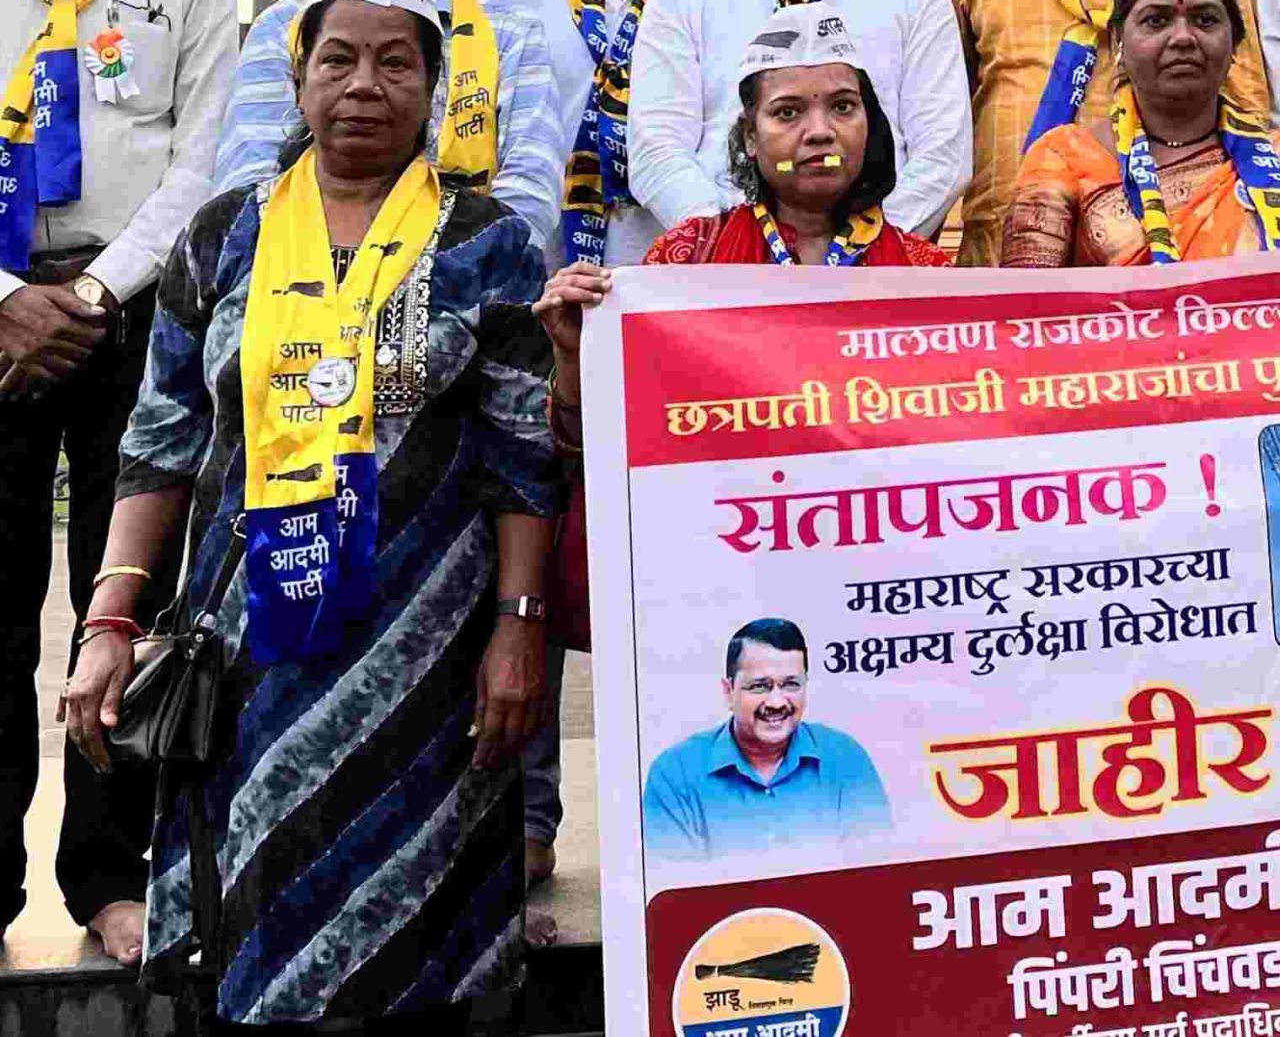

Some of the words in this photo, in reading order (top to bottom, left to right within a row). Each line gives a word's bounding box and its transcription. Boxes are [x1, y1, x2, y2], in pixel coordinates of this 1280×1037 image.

[455, 69, 478, 88] आम
[456, 114, 485, 141] पार्टी
[279, 341, 323, 360] आम
[838, 319, 998, 361] मालवण
[1008, 302, 1165, 349] राजकोट
[663, 380, 834, 438] छत्रपती
[842, 366, 1005, 426] शिवाजी
[1016, 350, 1243, 412] महाराजांचा
[279, 512, 318, 538] आम
[714, 460, 1168, 554] संतापजनक
[270, 535, 330, 571] आदमी
[844, 568, 1011, 618] महाराष्ट्र
[1021, 546, 1231, 599] सरकारच्या
[279, 568, 324, 601] पार्टी
[822, 630, 955, 676] अक्षम्य
[1098, 597, 1259, 650] विरोधात
[929, 687, 1275, 822] जाहीर
[911, 873, 1073, 951] आम
[704, 988, 745, 1011] झाडू
[1007, 946, 1138, 1020] पिंपरी
